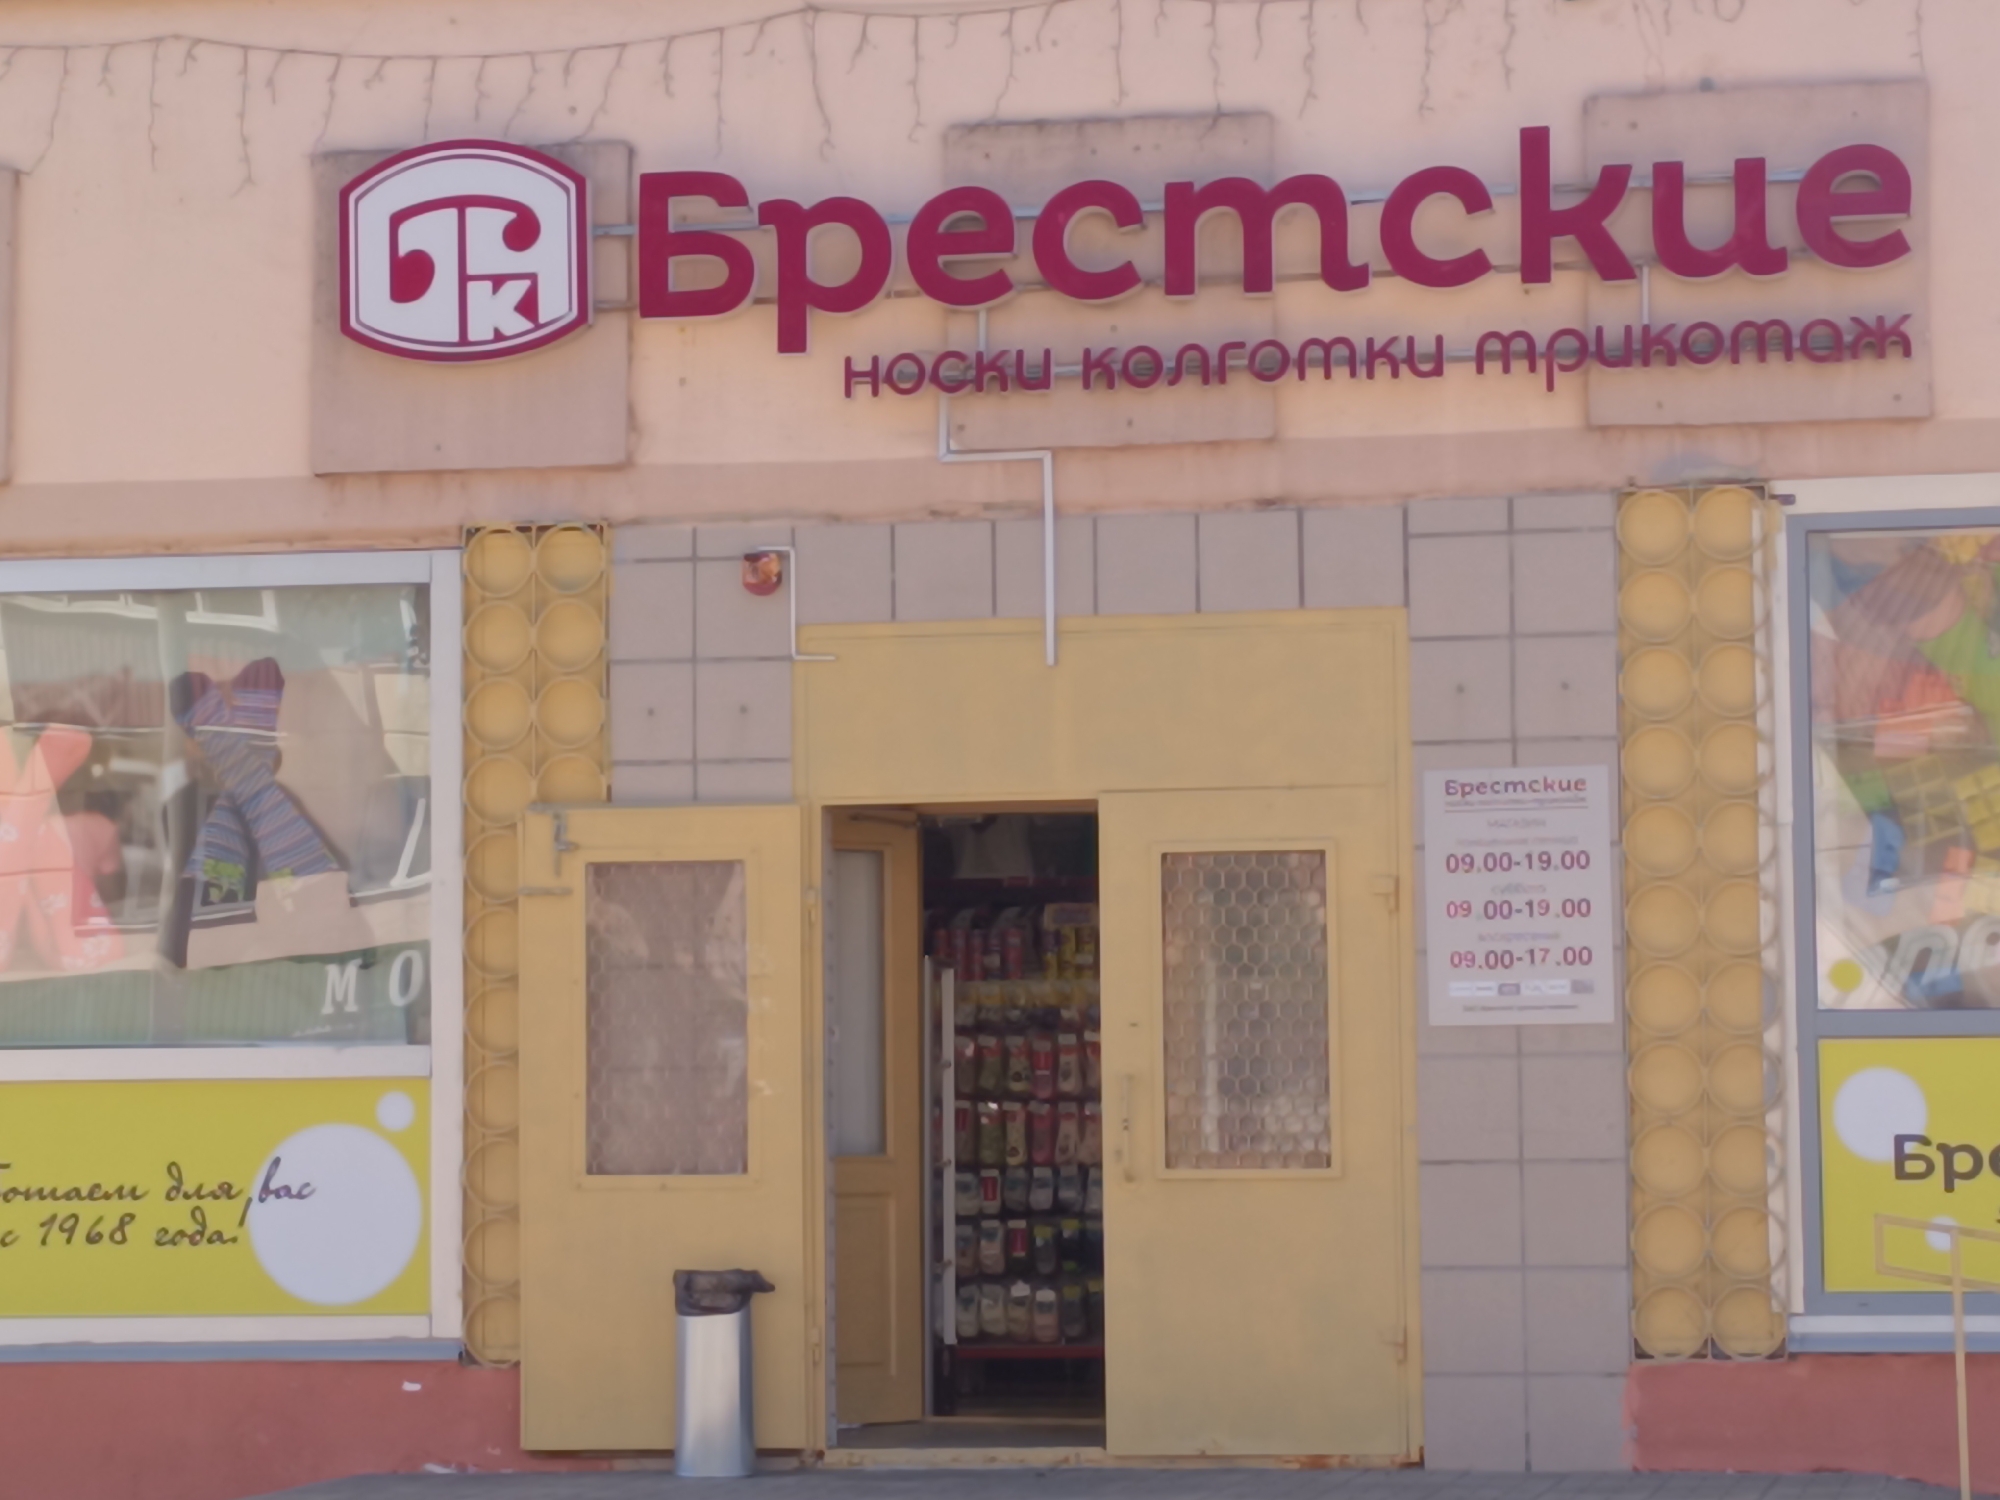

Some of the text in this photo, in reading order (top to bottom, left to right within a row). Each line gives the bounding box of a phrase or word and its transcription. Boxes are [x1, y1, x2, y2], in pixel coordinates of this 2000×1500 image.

[640, 126, 1913, 355] Брестские
[844, 313, 1914, 399] носки колготки трикотаж
[1444, 776, 1588, 798] Брестские
[1445, 850, 1591, 874] 09.00-19.00
[1445, 898, 1592, 921] 09.00-19.00
[1449, 946, 1594, 970] 09.00-17.00
[0, 1156, 317, 1203] отаем для вас
[39, 1212, 136, 1248] 1968
